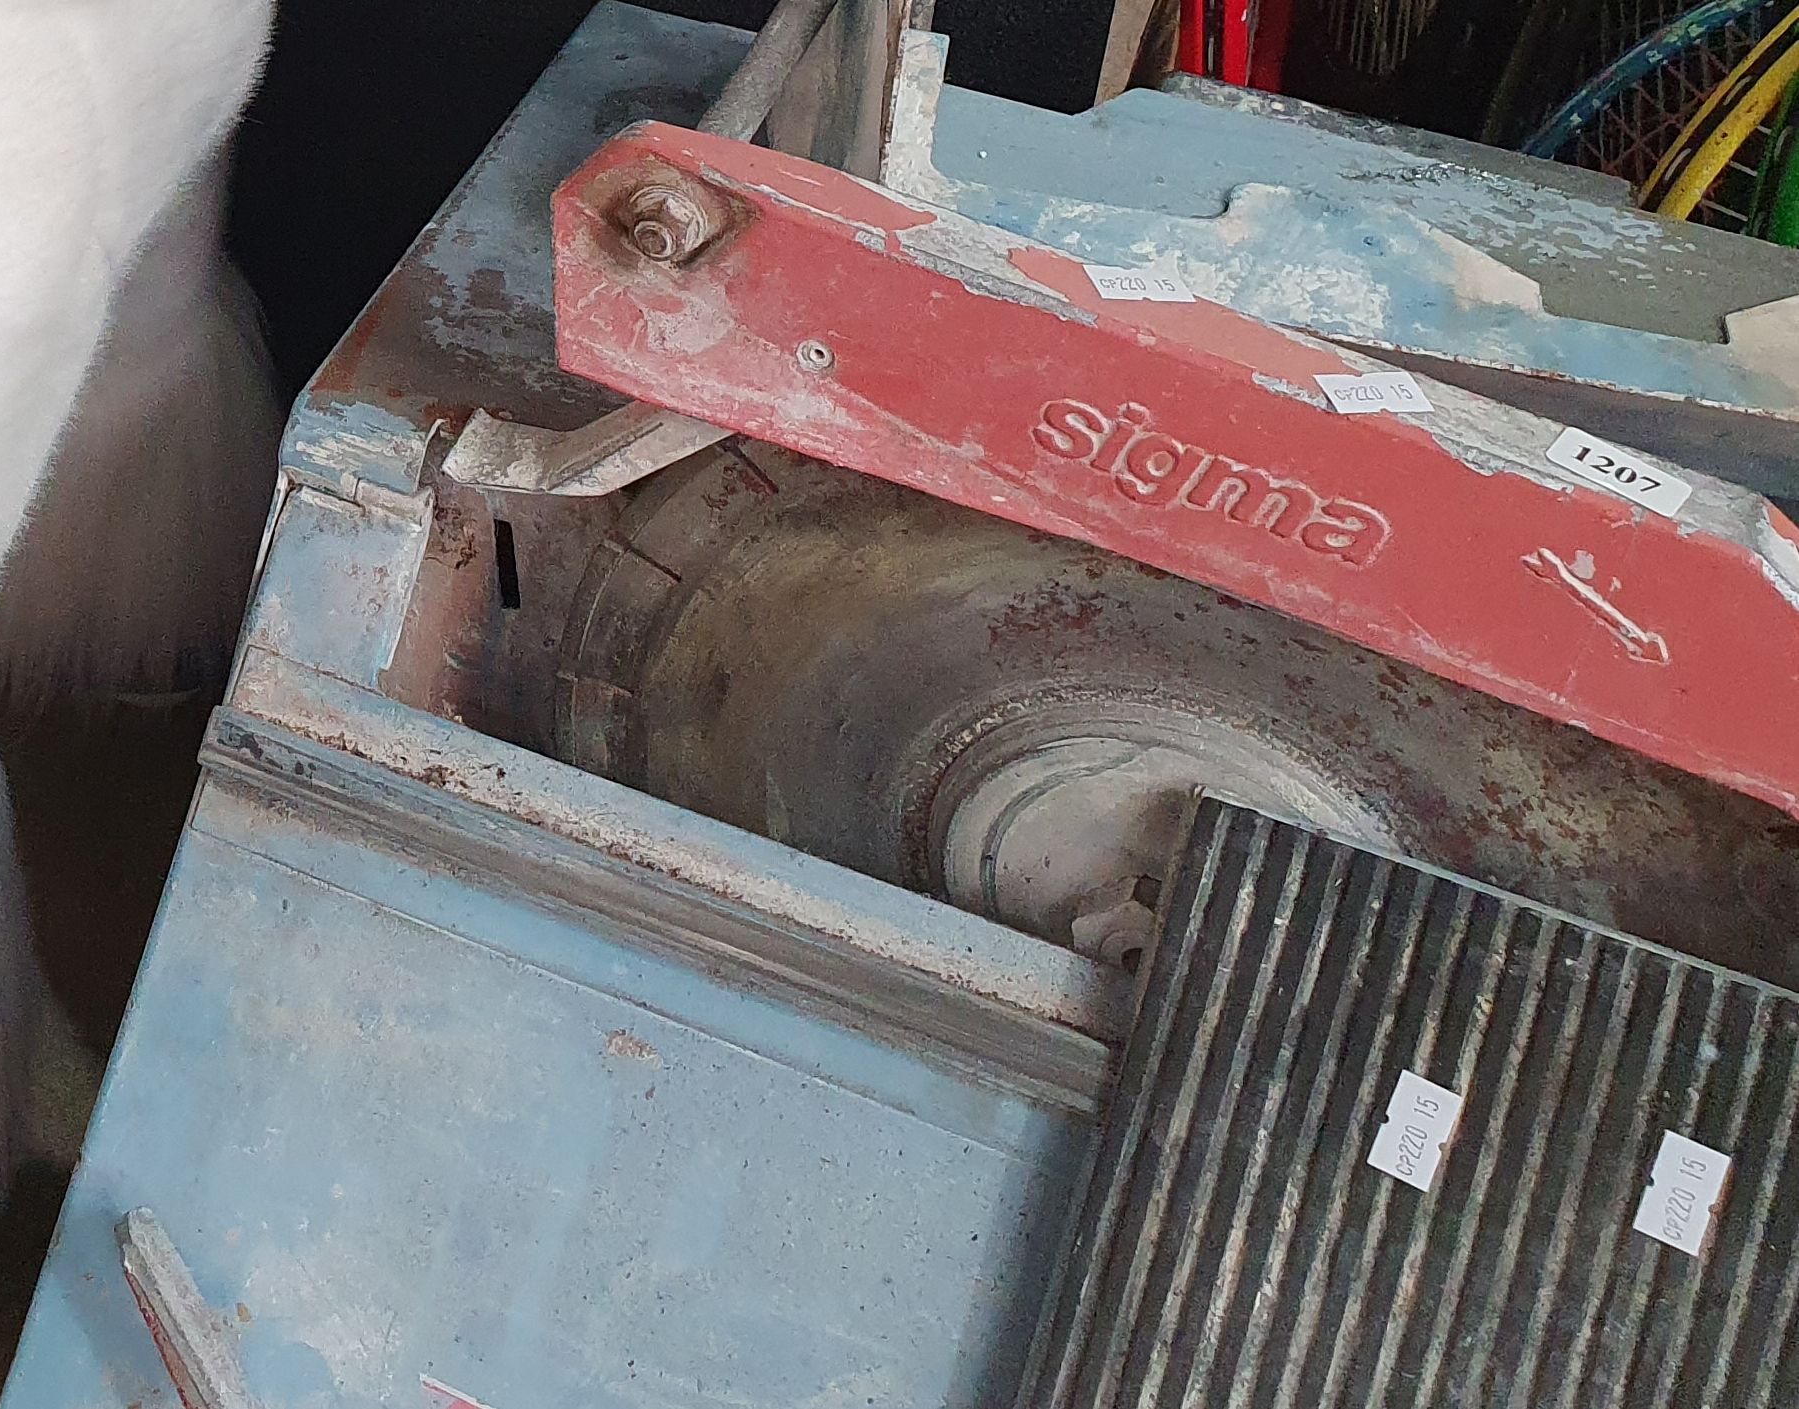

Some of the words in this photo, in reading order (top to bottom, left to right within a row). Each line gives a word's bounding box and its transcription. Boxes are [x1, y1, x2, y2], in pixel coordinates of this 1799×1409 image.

[1099, 278, 1146, 291] CP220
[1154, 278, 1175, 292] 15
[1389, 384, 1413, 400] 15
[1029, 397, 1393, 571] sigma
[1572, 444, 1662, 492] 1207
[1395, 1125, 1428, 1176] CP220
[1413, 1095, 1439, 1119] 15
[1679, 1156, 1707, 1180] 15
